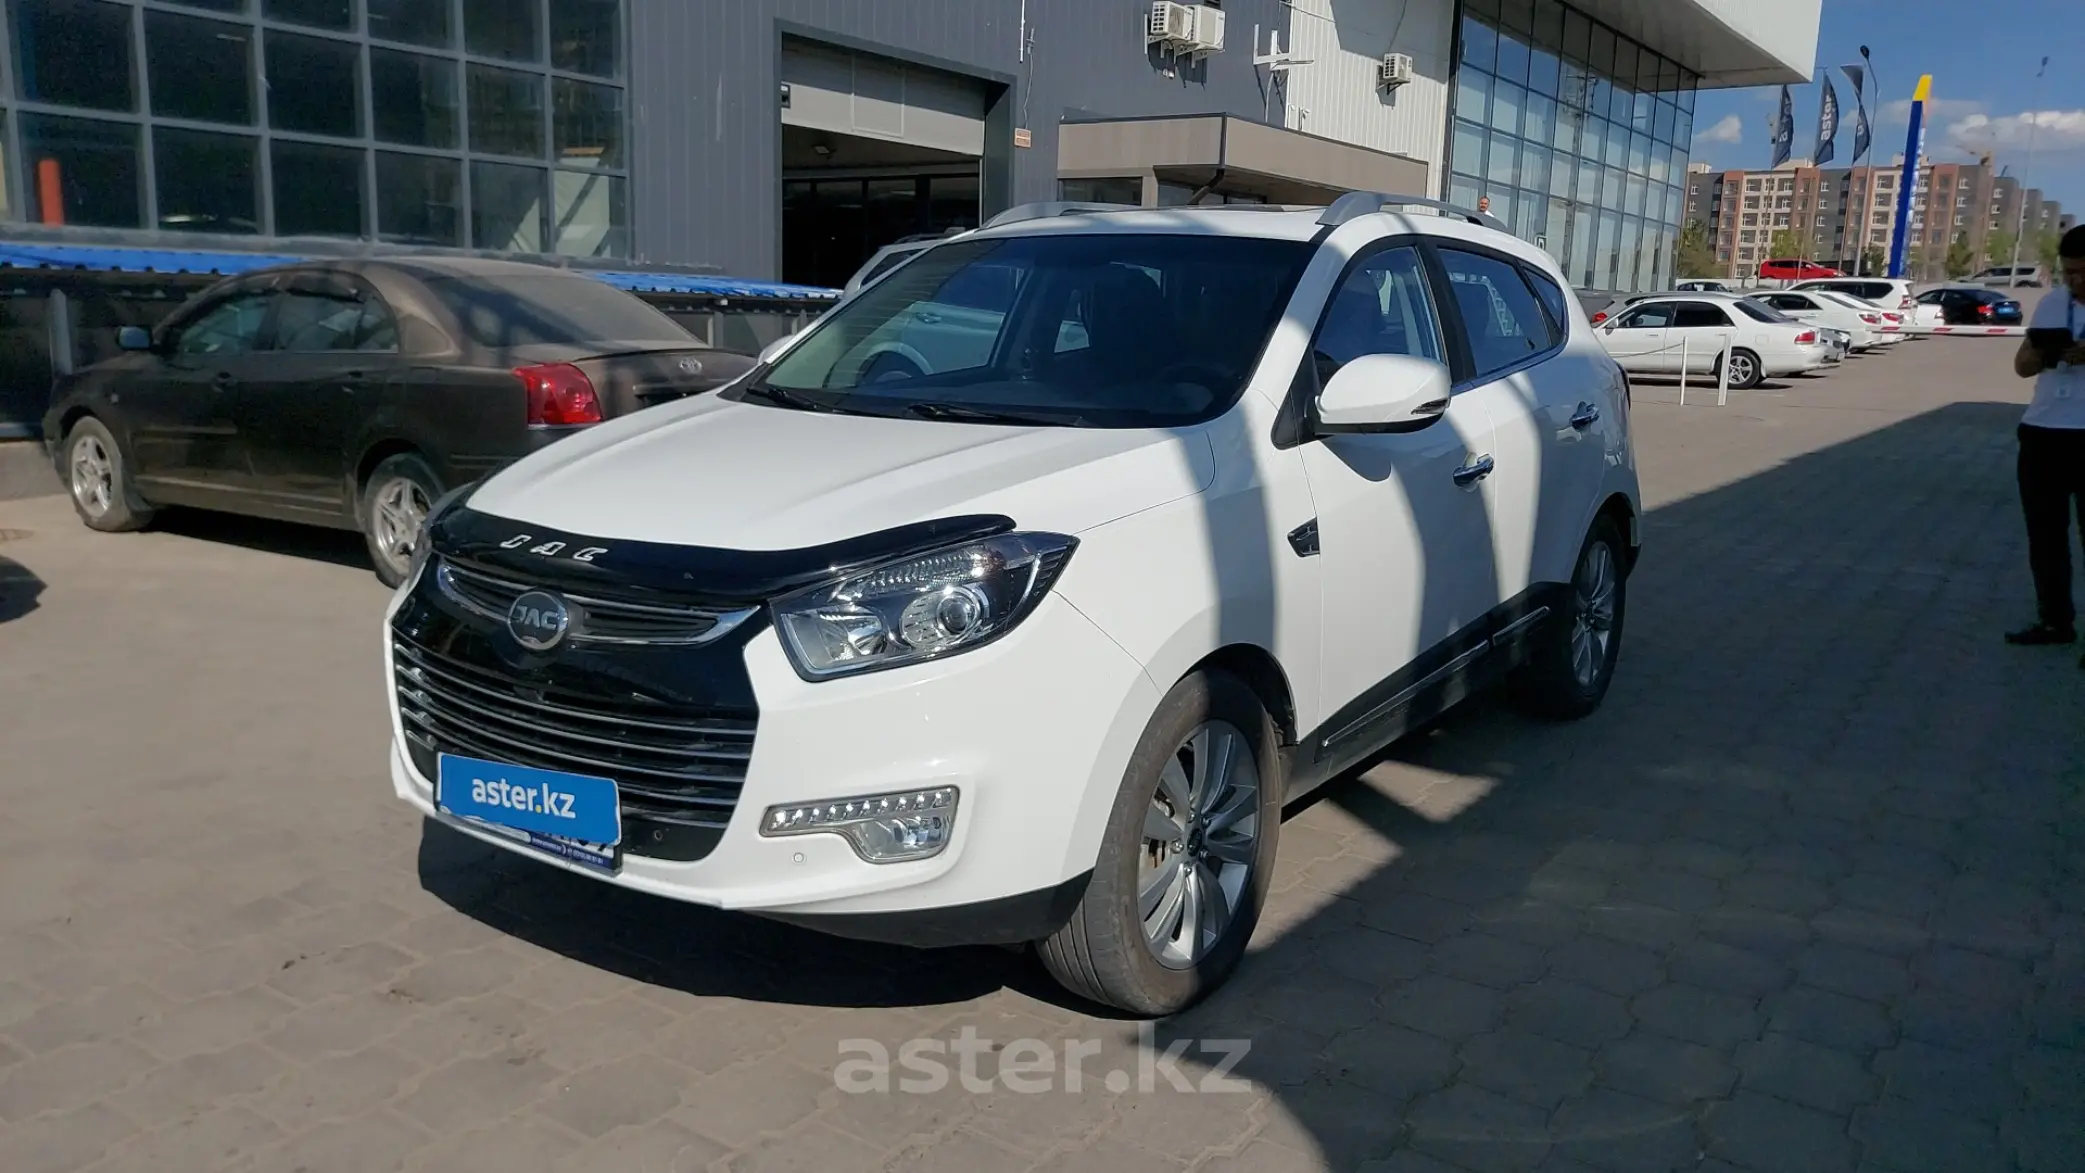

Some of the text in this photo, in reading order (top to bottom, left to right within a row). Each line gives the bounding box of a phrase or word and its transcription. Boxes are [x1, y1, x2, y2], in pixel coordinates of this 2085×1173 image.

[500, 534, 608, 562] JAC
[512, 604, 560, 631] JAC
[471, 778, 576, 819] aster.kz
